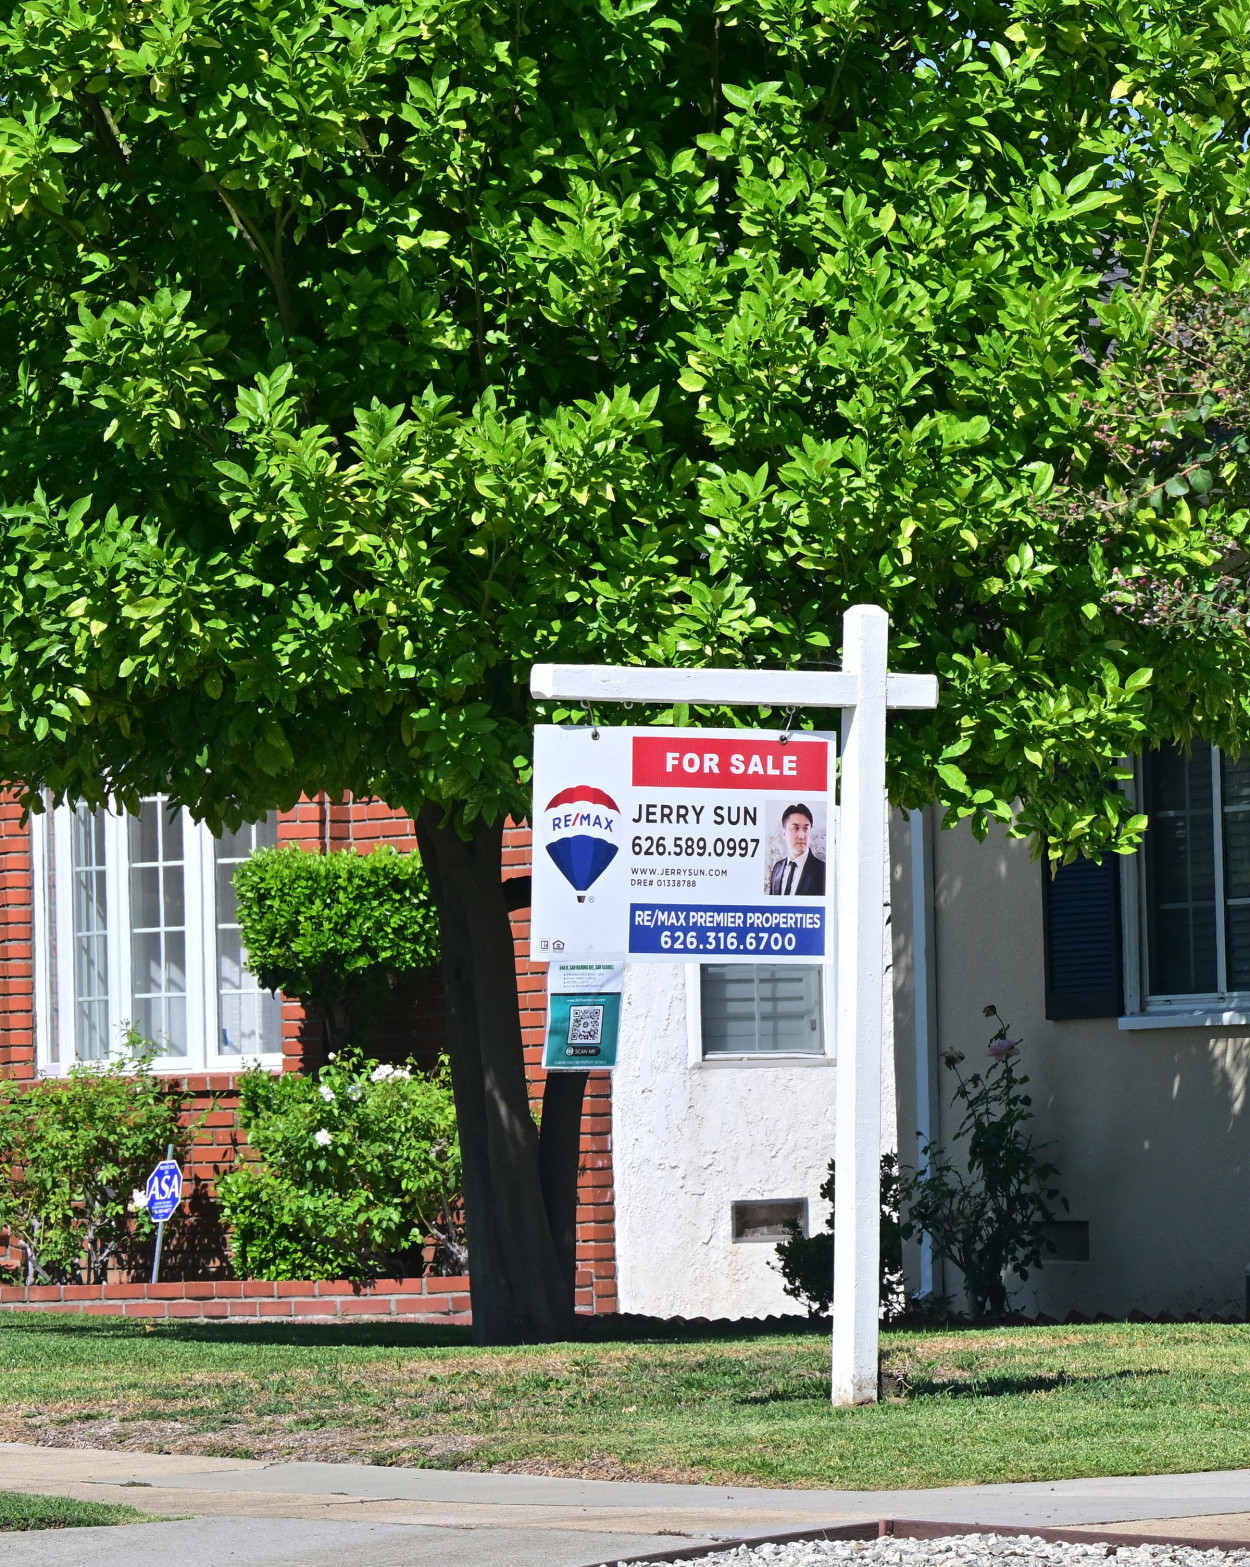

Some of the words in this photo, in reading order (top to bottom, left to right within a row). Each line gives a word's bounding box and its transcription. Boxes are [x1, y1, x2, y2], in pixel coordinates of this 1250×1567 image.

[666, 752, 720, 774] FOR
[730, 754, 798, 776] SALE
[552, 812, 614, 833] RE/MAX
[632, 804, 705, 824] JERRY
[713, 805, 757, 826] SUN
[632, 836, 760, 857] 626.589.0997
[631, 867, 728, 877] WWW.JERRYSUN.COM
[630, 879, 654, 887] DRE#
[657, 879, 697, 888] 01338788
[635, 909, 686, 928] RE/MAX
[689, 911, 744, 928] PREMIER
[746, 913, 821, 928] PROPERTIES
[660, 930, 796, 950] 626.316.6700
[148, 1174, 179, 1200] ASA
